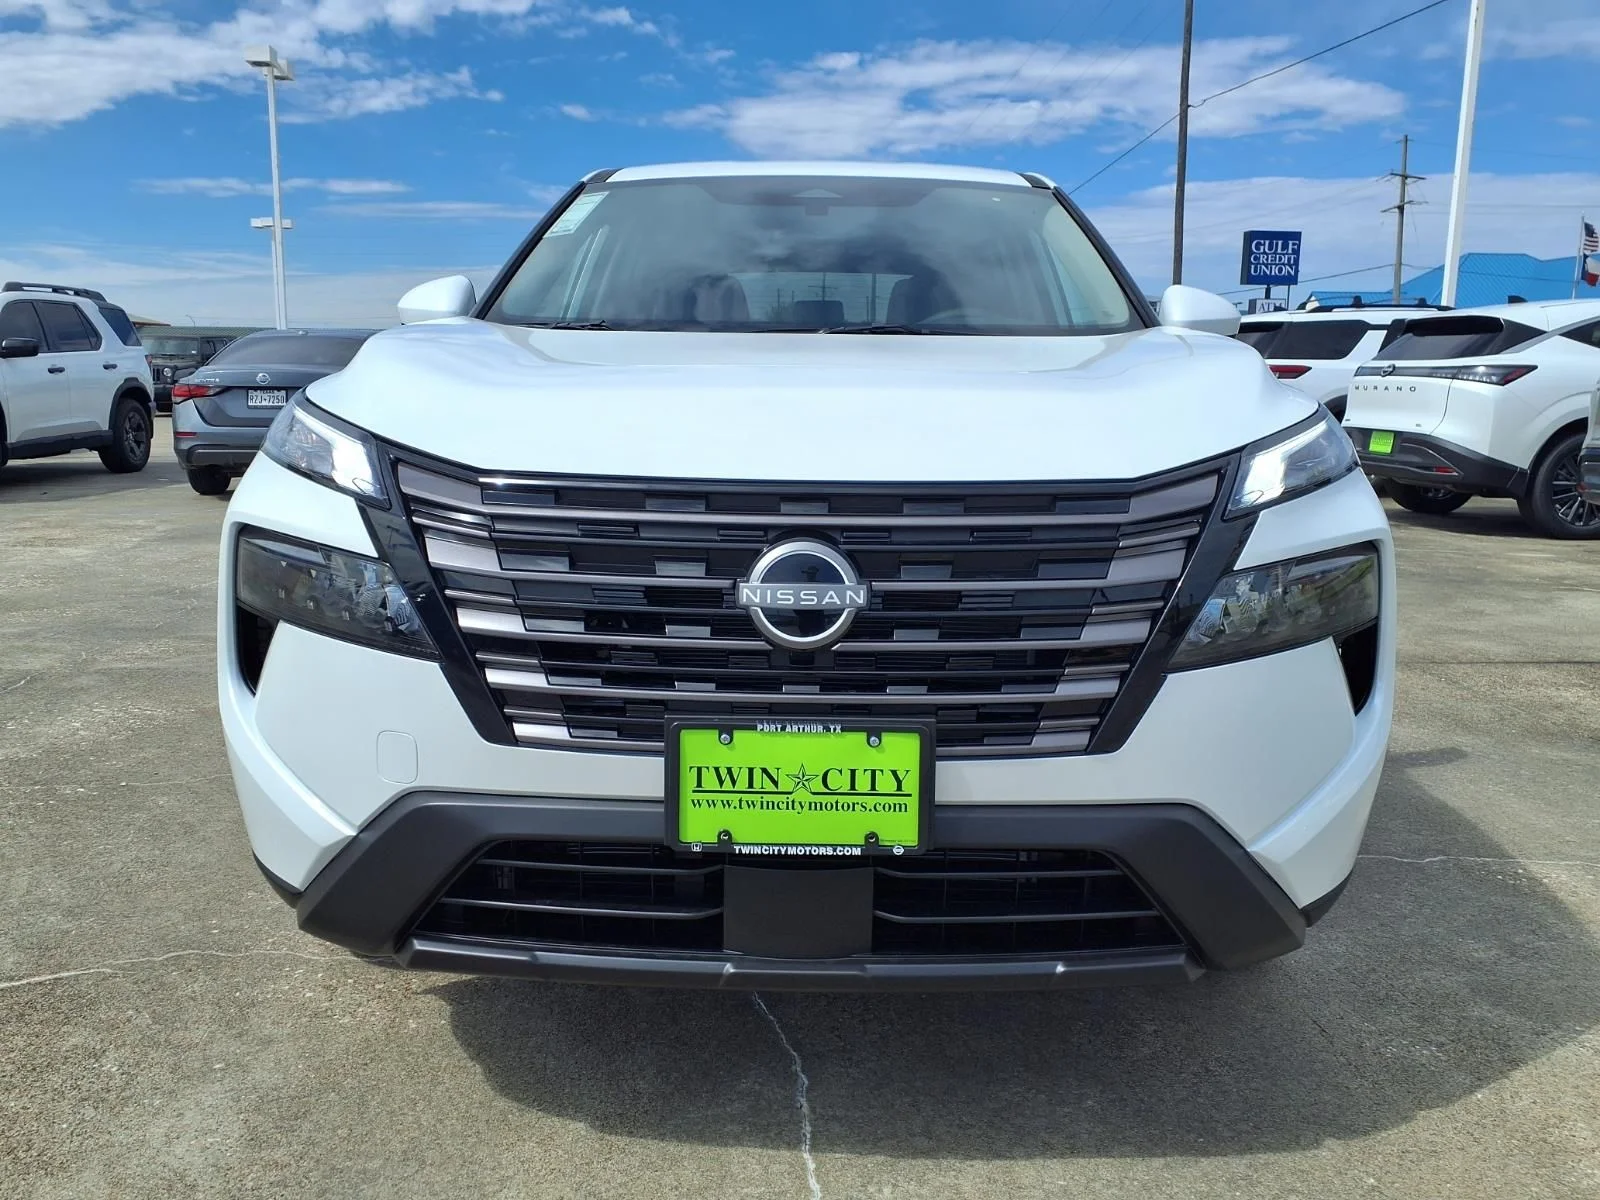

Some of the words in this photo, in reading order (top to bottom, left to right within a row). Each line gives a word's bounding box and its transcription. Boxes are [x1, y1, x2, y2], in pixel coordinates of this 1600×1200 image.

[1251, 239, 1299, 254] GULF
[1250, 253, 1297, 265] CREDIT
[1250, 264, 1296, 276] UNION
[1354, 385, 1417, 393] MURANO
[742, 587, 865, 605] NISSAN
[757, 724, 782, 733] PORT
[829, 724, 842, 734] TX
[689, 765, 782, 790] TWIN
[821, 767, 912, 792] CITY
[690, 795, 908, 815] www.twincitymotors.com
[733, 845, 861, 856] TWINCITYMOTORS.COM
